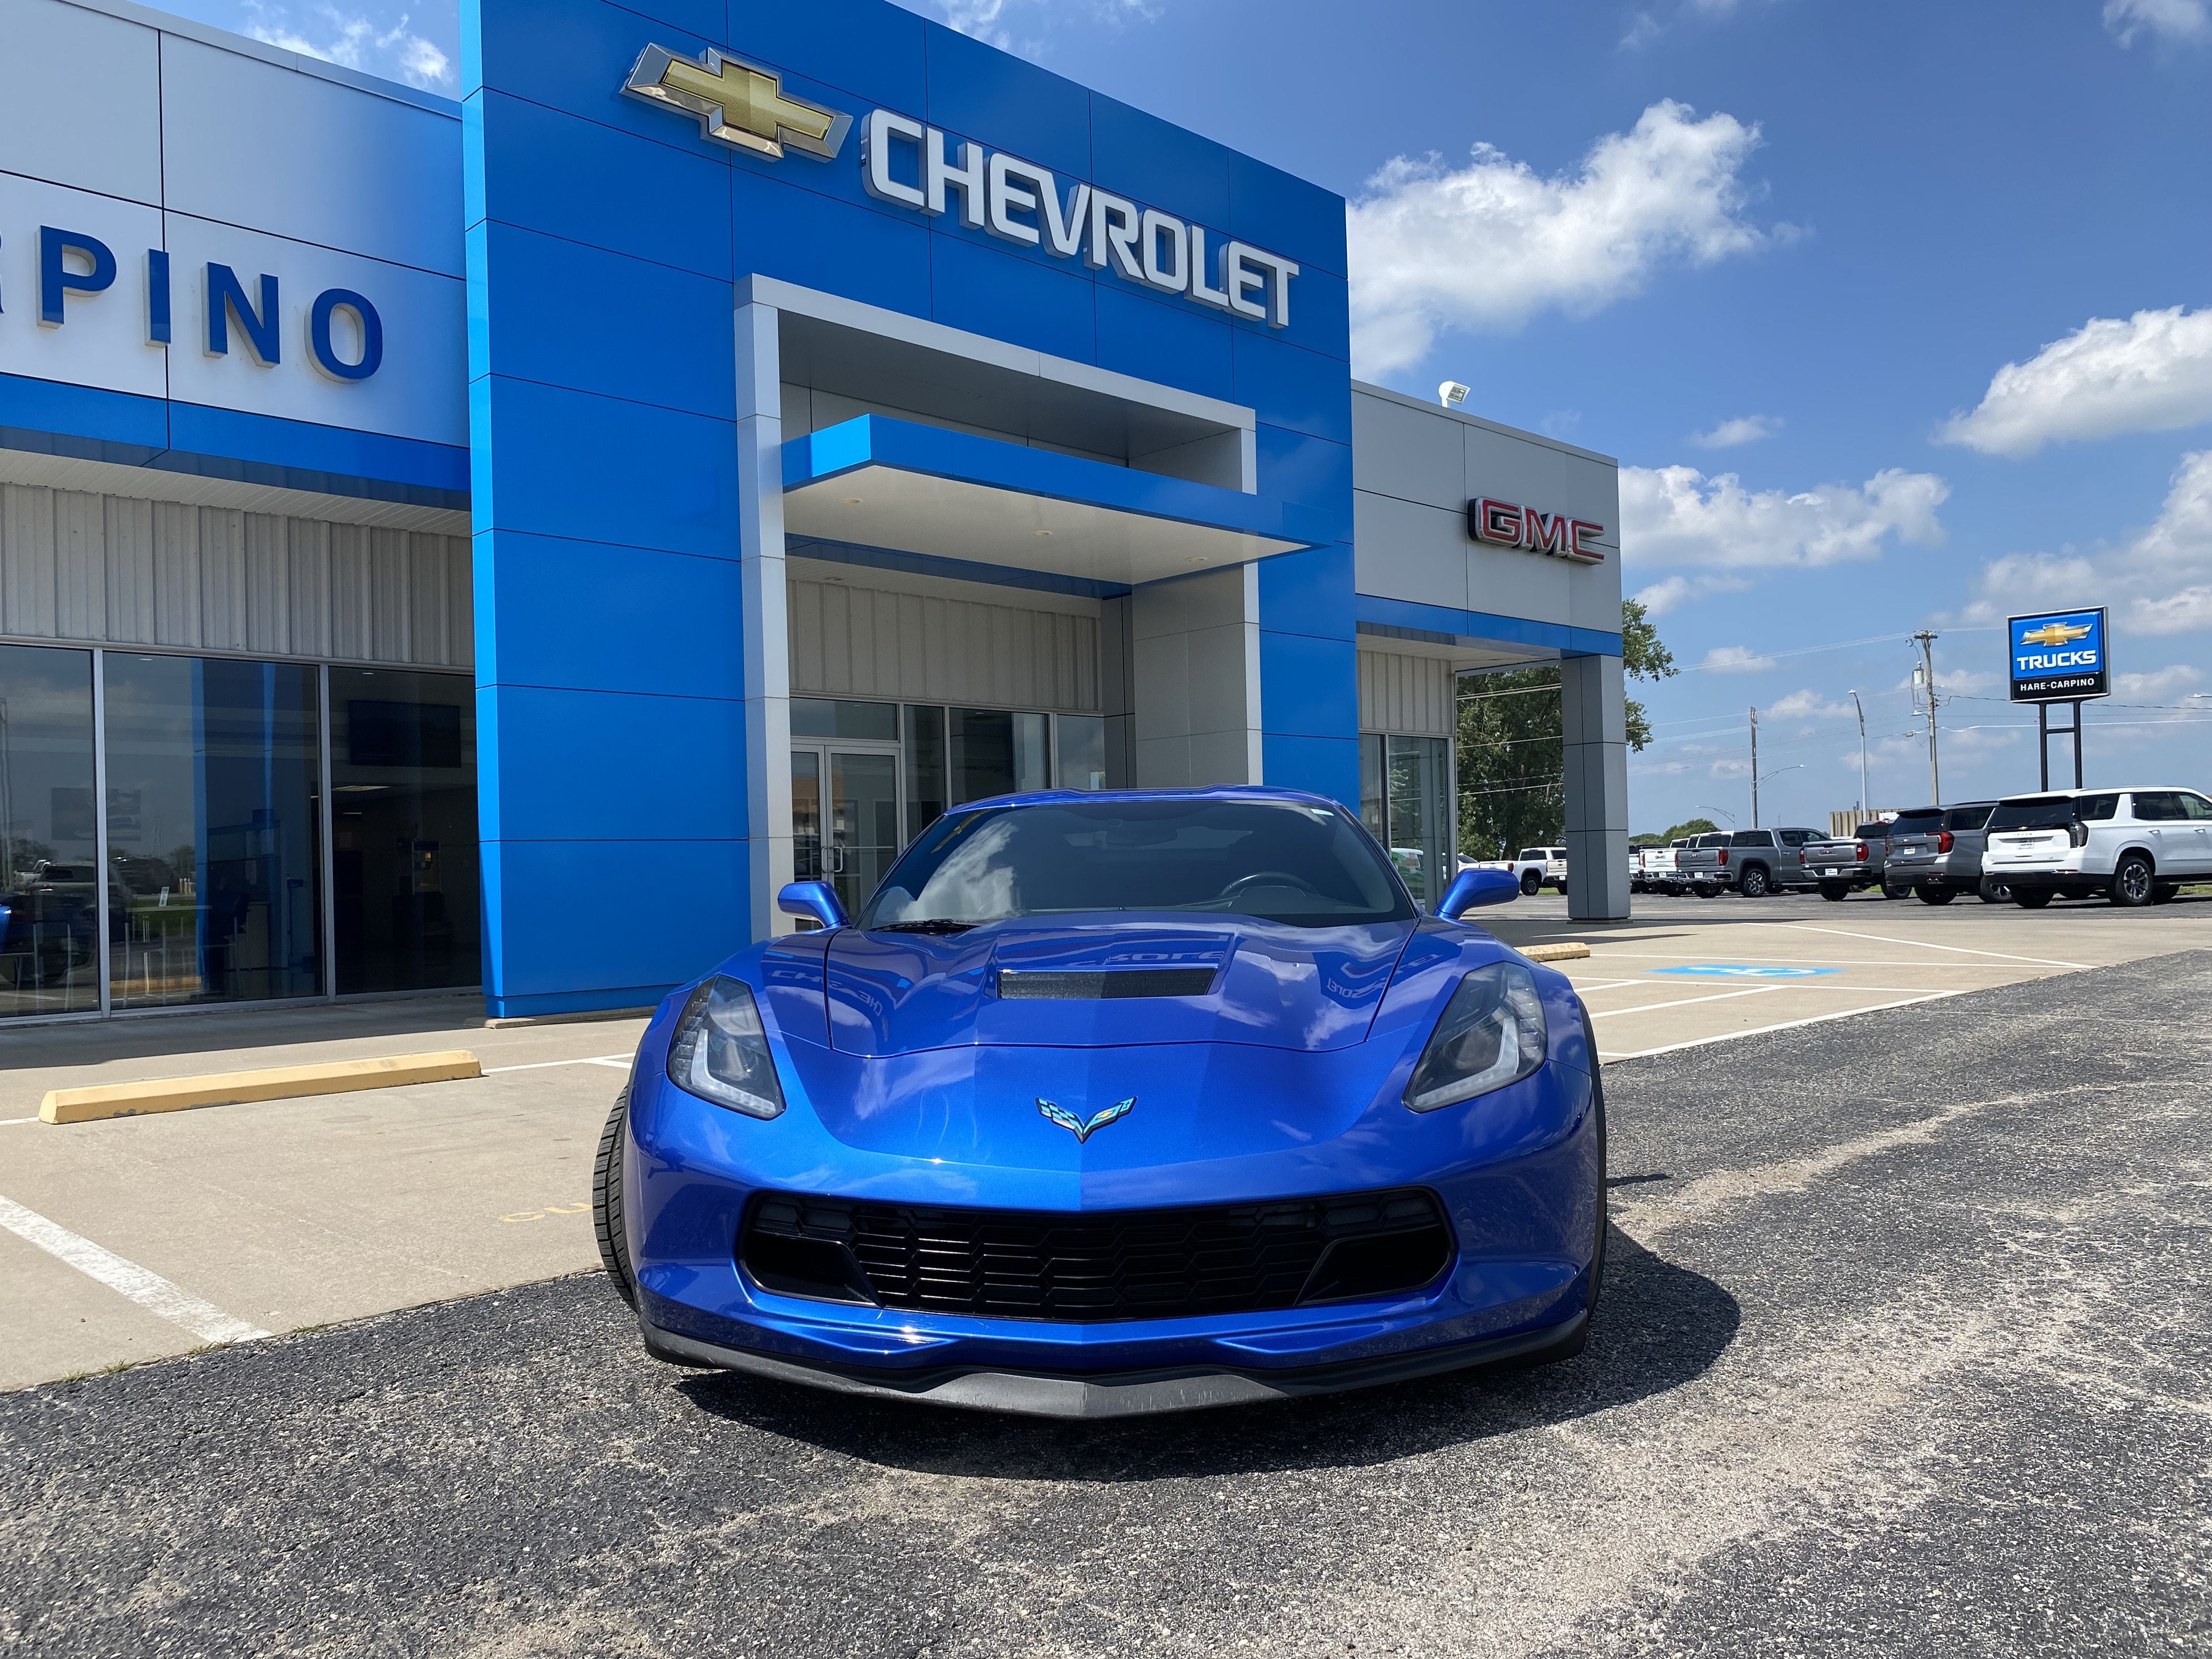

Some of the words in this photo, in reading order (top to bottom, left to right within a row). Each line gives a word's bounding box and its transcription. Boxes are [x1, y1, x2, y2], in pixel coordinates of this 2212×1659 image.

[861, 109, 1300, 329] CHEVROLET
[0, 225, 383, 382] PINO
[1468, 496, 1605, 565] GMC
[2017, 650, 2096, 670] TRUCKS
[2020, 678, 2095, 691] HARE-CARPINO
